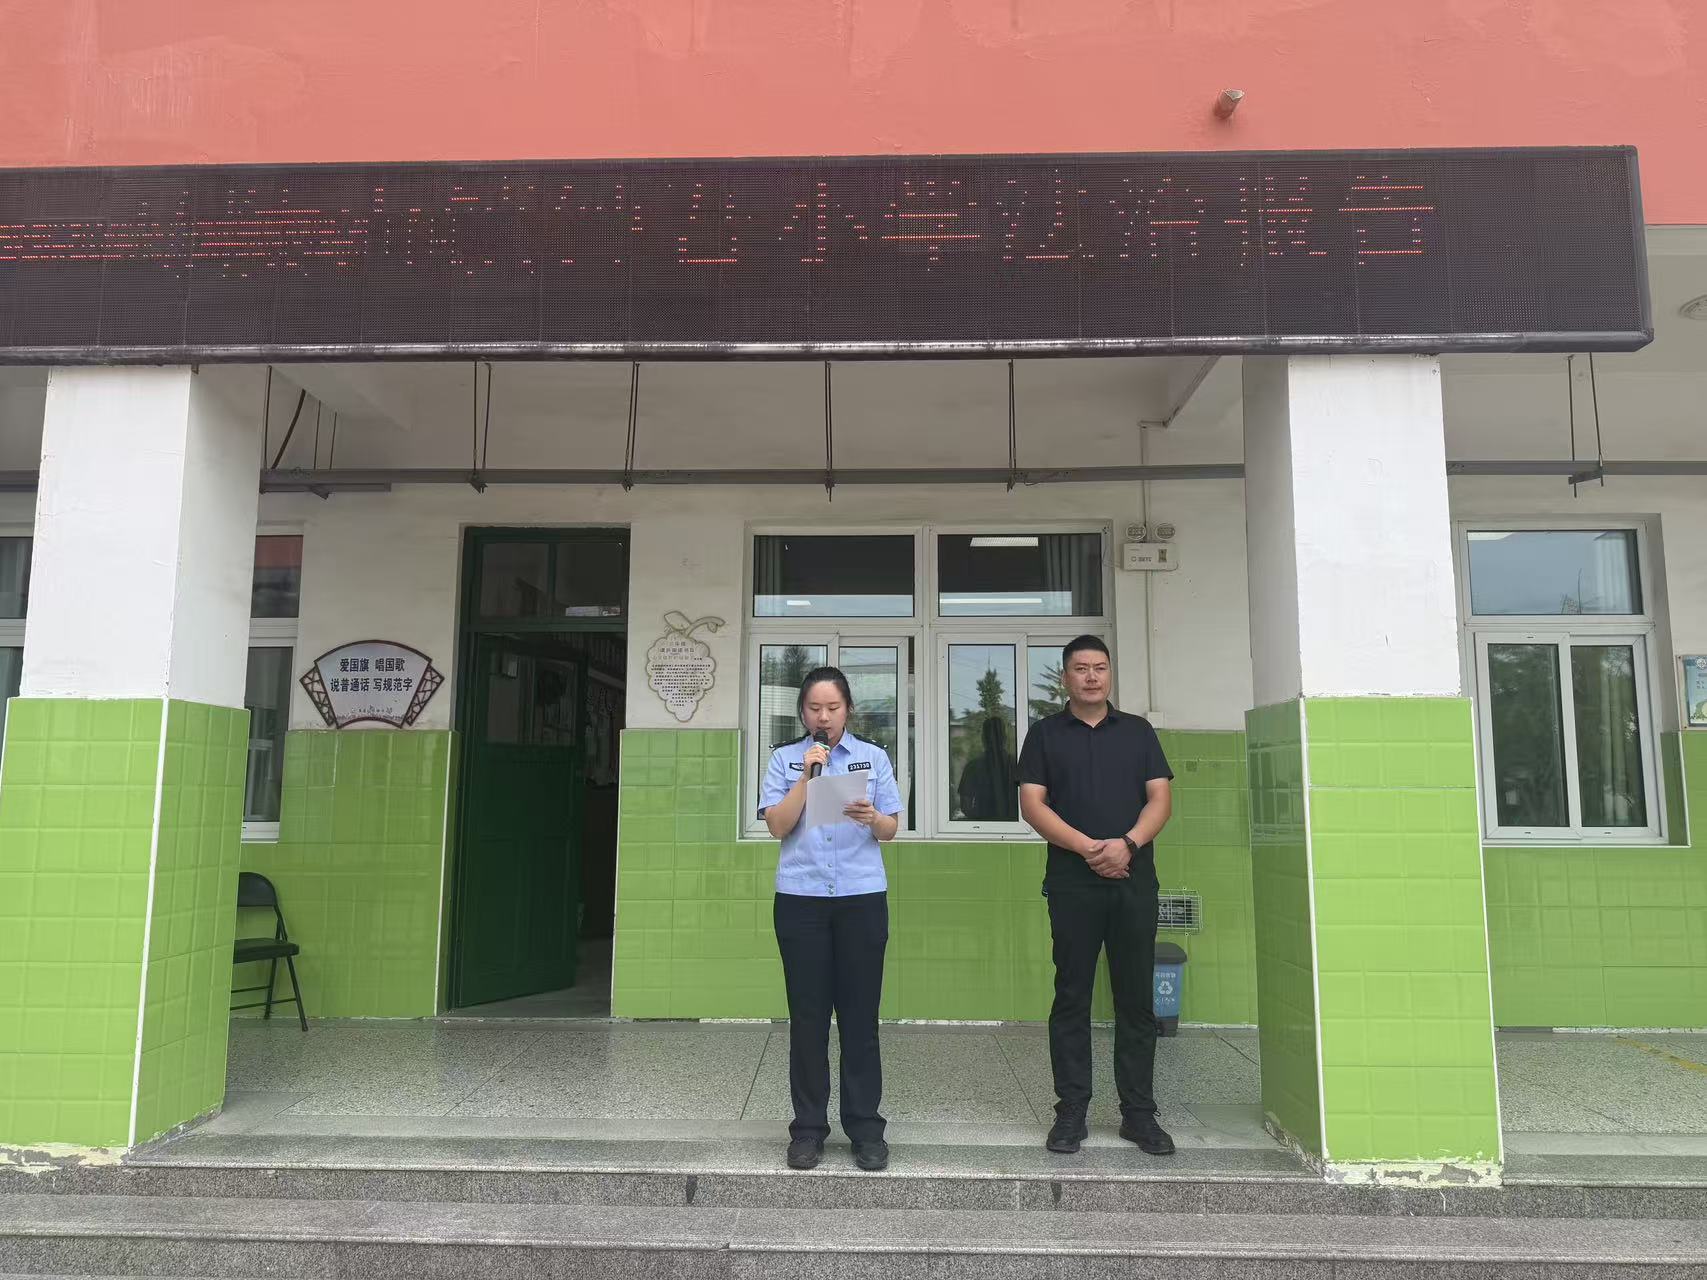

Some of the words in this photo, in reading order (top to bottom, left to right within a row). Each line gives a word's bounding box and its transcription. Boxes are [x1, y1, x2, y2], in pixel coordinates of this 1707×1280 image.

[340, 658, 370, 672] 爱国旗
[375, 657, 405, 672] 唱国歌
[330, 678, 370, 692] 说普通话
[373, 677, 413, 692] 写规范字
